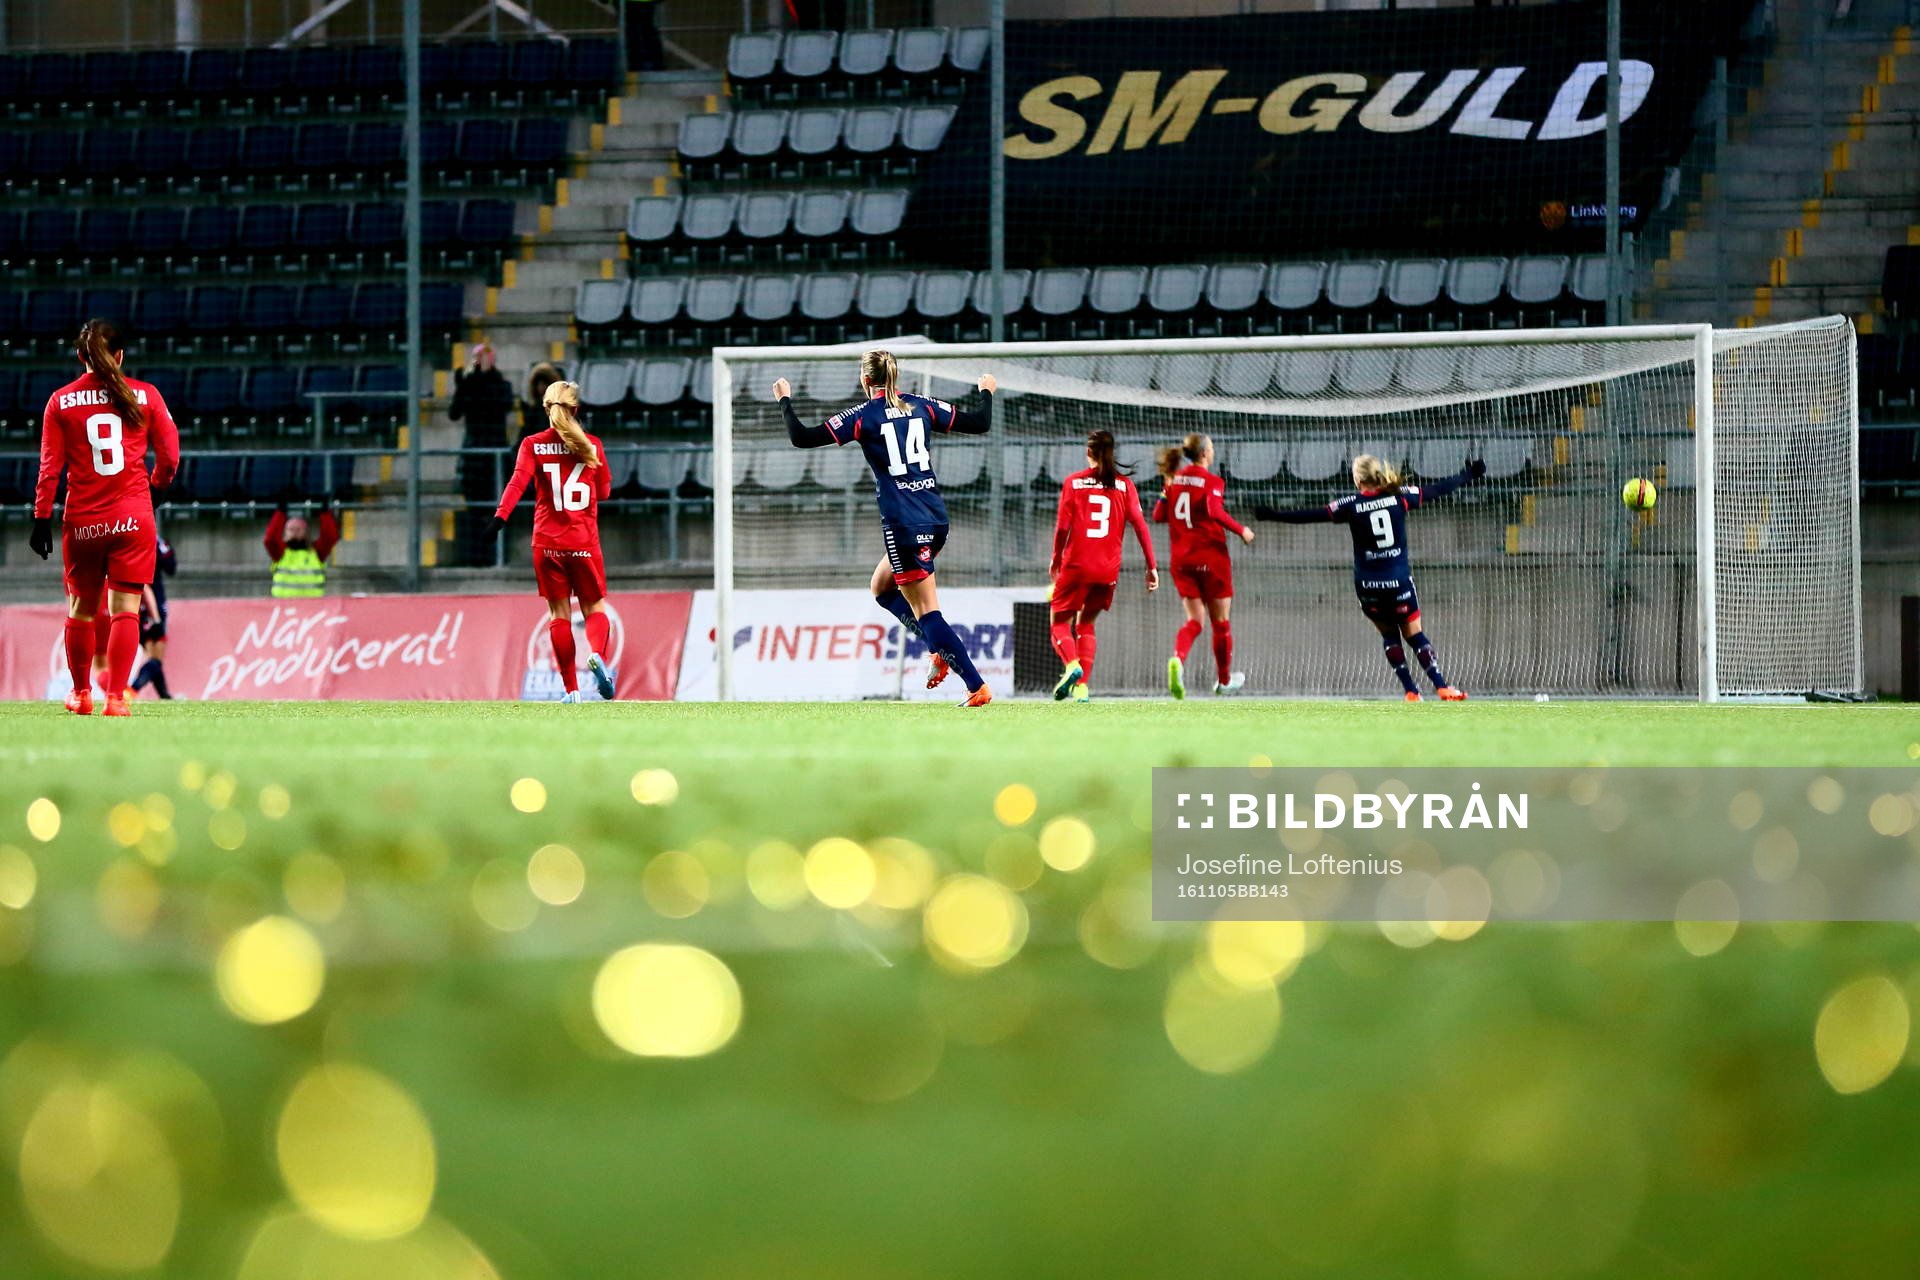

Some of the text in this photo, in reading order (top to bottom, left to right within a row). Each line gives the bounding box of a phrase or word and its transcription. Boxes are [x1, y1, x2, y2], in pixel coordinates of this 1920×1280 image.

[1002, 59, 1655, 160] SM-GULD
[1571, 204, 1637, 218] Linköng
[59, 389, 148, 410] ESKILSA
[86, 413, 125, 476] 8
[880, 418, 931, 477] 14
[542, 462, 591, 512] 16
[1174, 491, 1194, 529] 4
[1086, 494, 1111, 539] 3
[1369, 508, 1395, 549] 9
[234, 606, 349, 655] När-
